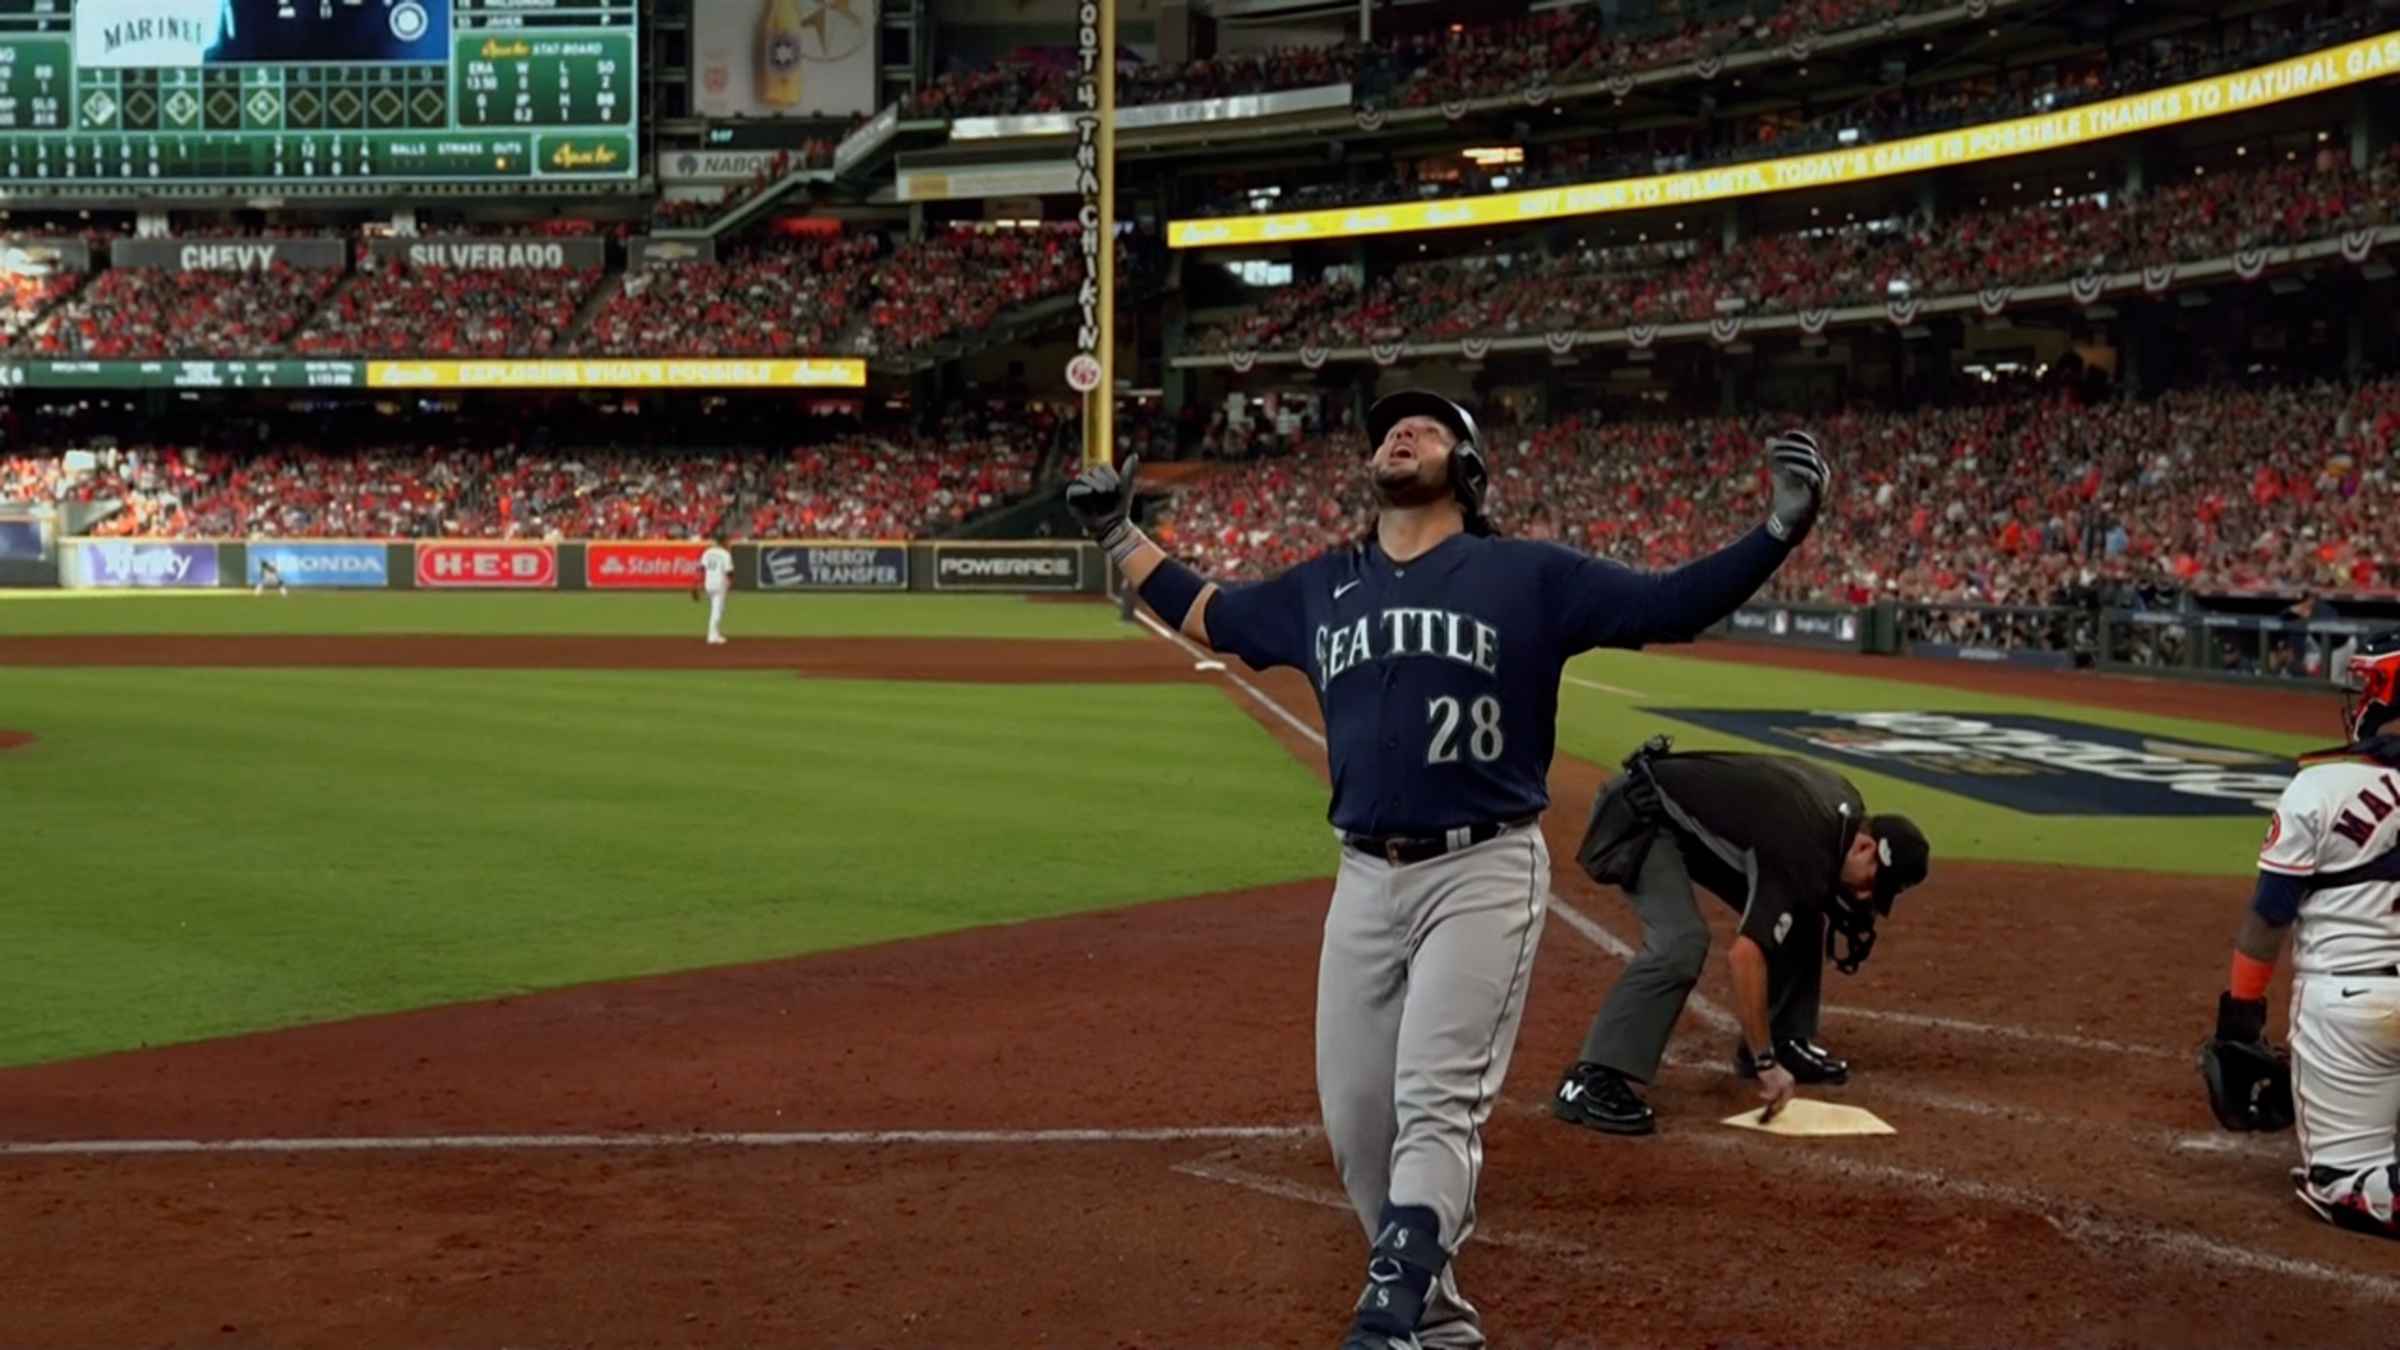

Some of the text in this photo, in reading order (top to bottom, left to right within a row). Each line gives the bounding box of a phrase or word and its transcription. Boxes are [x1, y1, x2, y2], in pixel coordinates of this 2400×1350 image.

[1080, 0, 1098, 72] OOT
[1970, 118, 2080, 153] POSSIBLE
[2090, 94, 2183, 131] THANKS
[2190, 85, 2222, 110] TO
[2229, 56, 2340, 105] NATURAL
[2347, 37, 2400, 74] GAS
[704, 156, 770, 173] NABO
[180, 244, 275, 271] CHEVY
[410, 244, 563, 268] SILVERADO
[628, 556, 670, 575] State
[808, 551, 875, 566] ENERGY
[812, 567, 897, 583] TRANSFER
[1315, 607, 1497, 692] SEATTLE
[1427, 695, 1504, 763] 28
